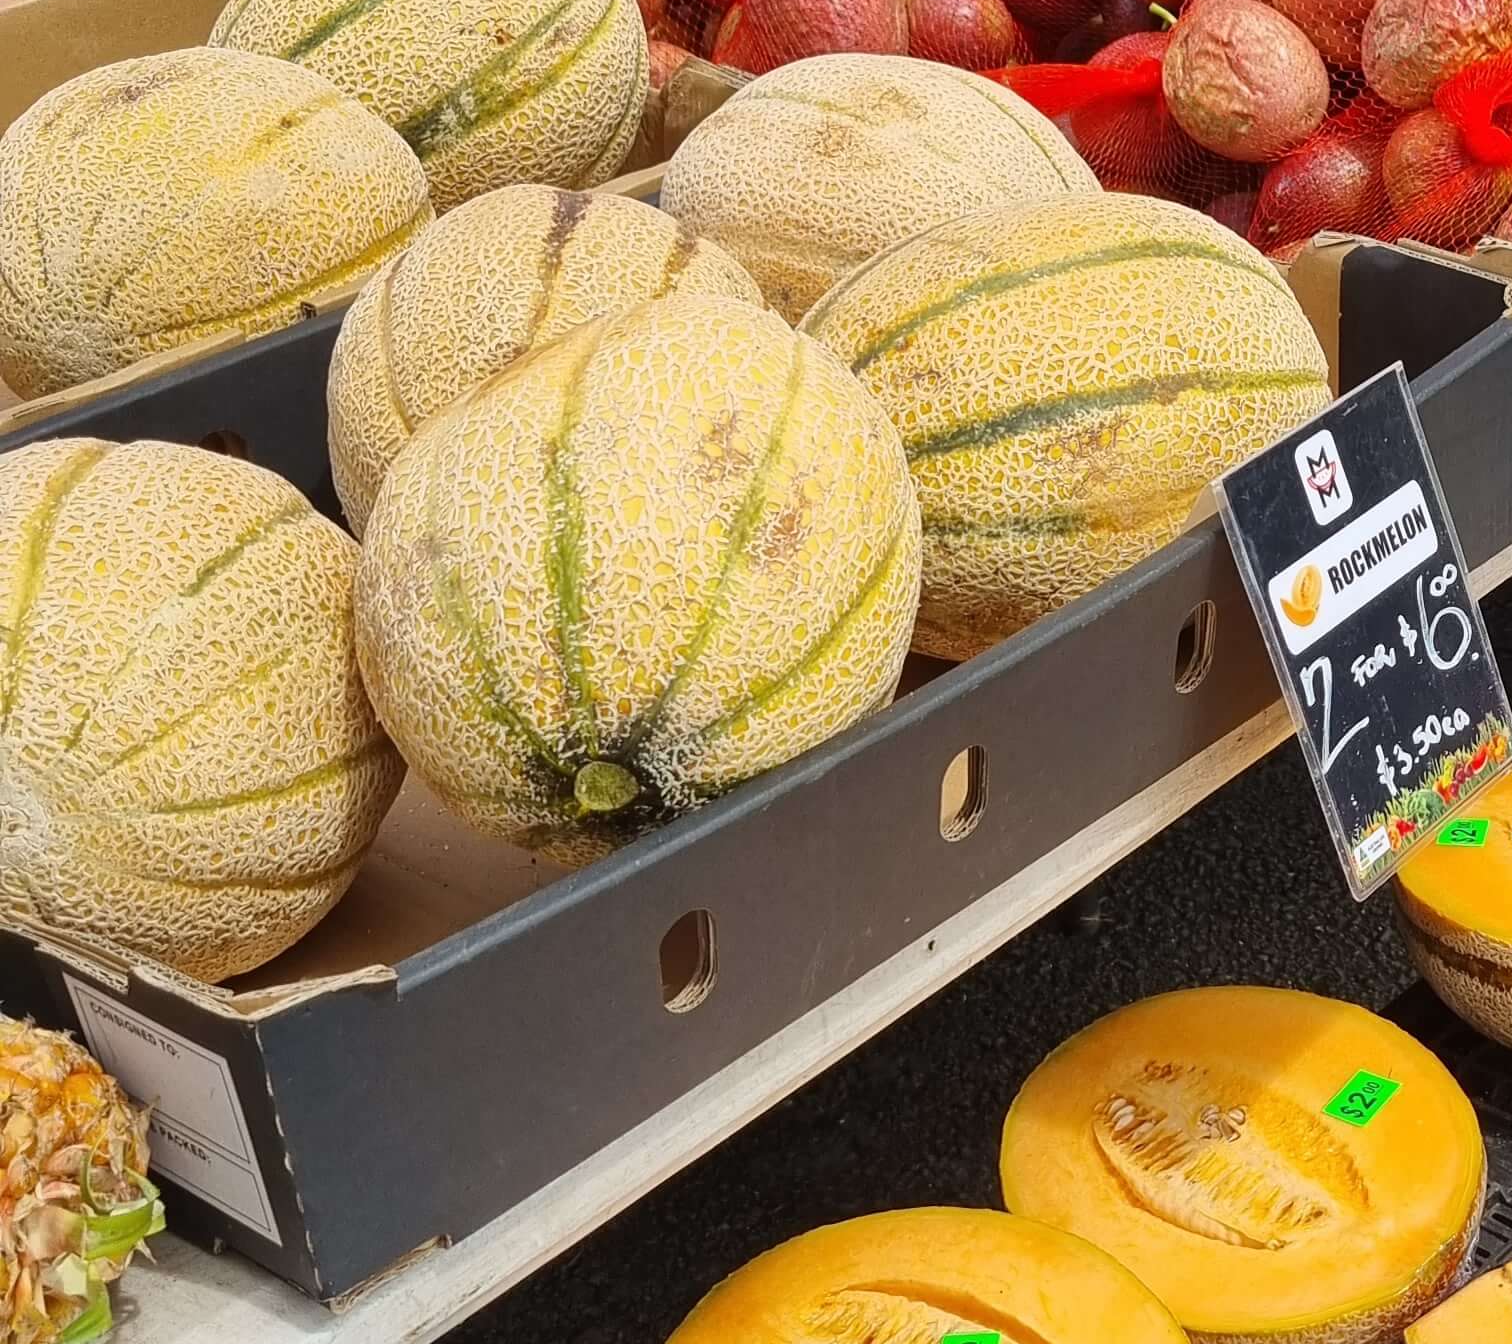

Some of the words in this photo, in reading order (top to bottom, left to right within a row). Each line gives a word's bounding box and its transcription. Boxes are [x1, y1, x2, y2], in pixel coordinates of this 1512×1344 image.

[1327, 504, 1428, 594] ROCKMELON
[1299, 656, 1370, 774] 2
[90, 1001, 158, 1047] CONSIGNED
[160, 1128, 212, 1167] PACKED:
